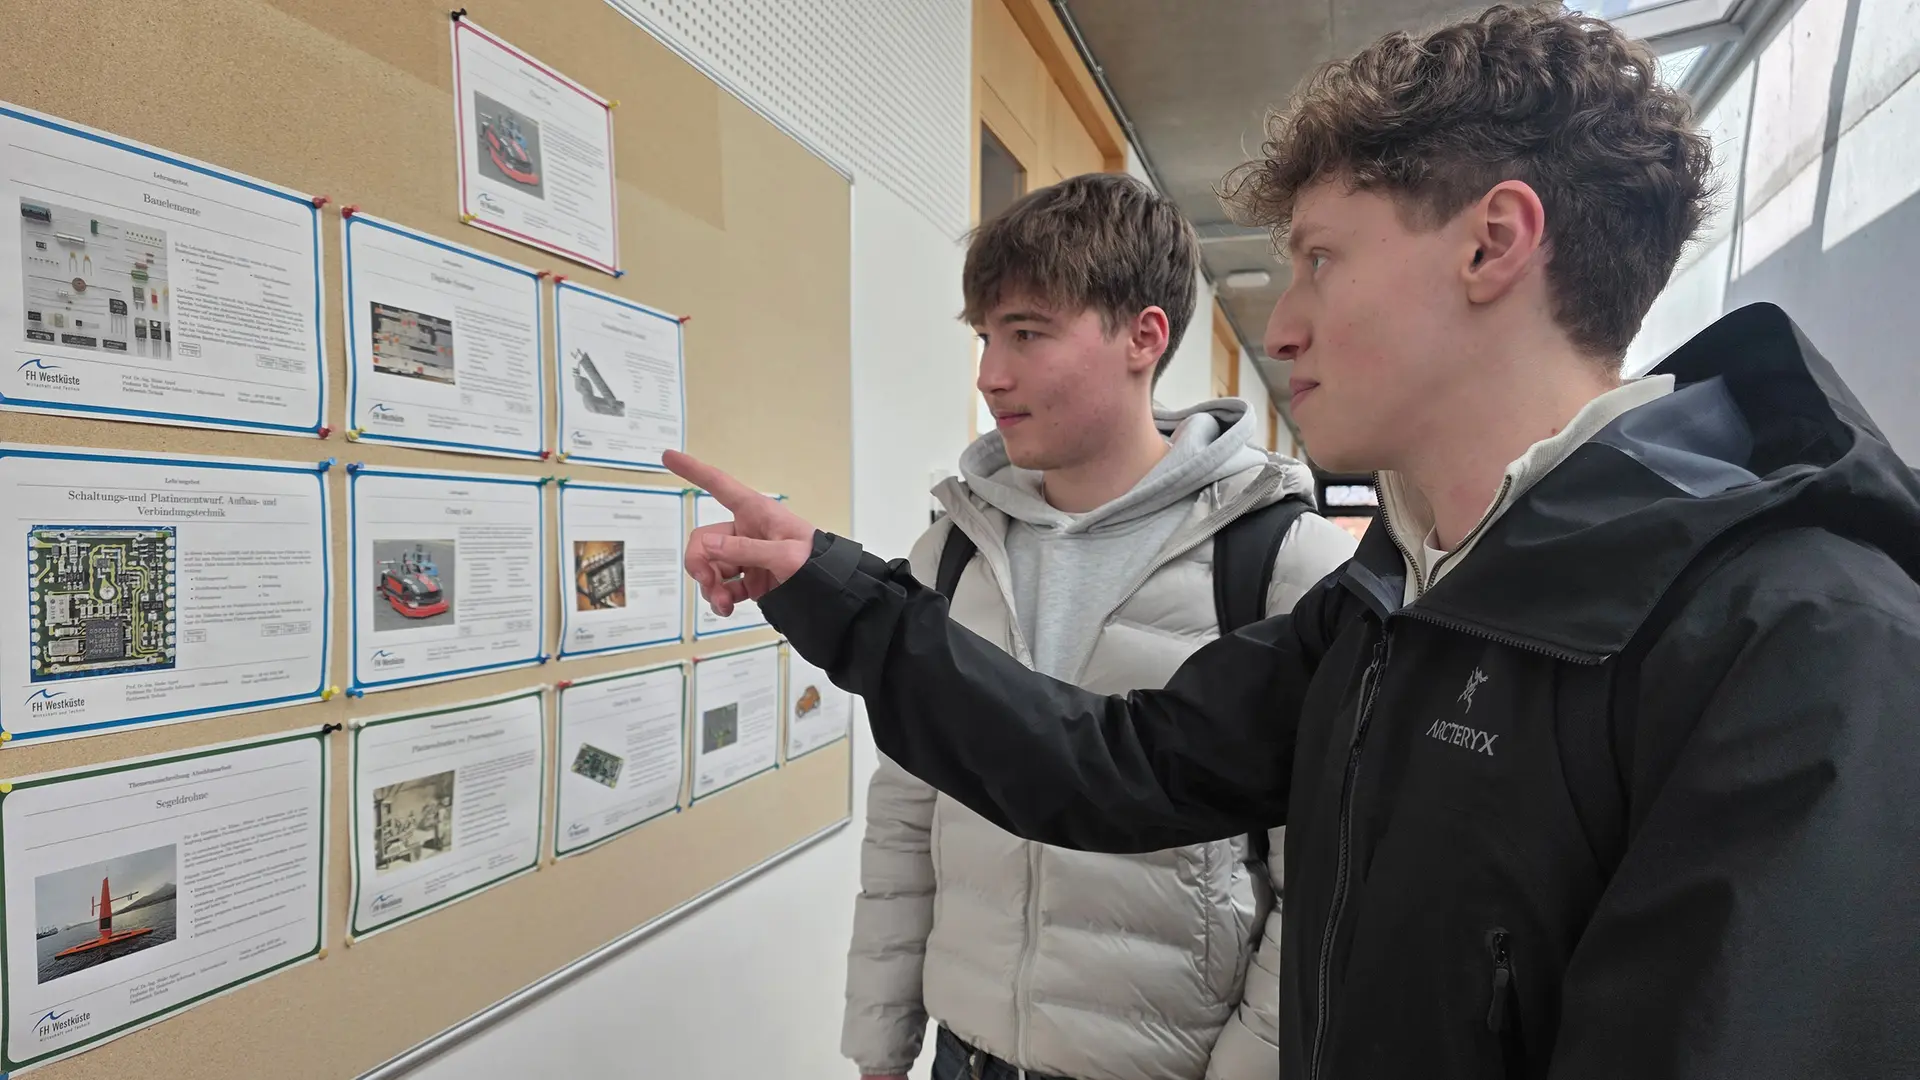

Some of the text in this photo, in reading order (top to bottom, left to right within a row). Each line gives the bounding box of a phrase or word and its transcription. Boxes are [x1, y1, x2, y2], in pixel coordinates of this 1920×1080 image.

[143, 193, 201, 216] Bauelemente
[25, 370, 80, 385] FH Westküste
[68, 490, 147, 504] Schaltungs-und
[262, 498, 277, 506] und
[137, 506, 226, 518] Verbindungstechnik
[32, 697, 85, 712] FH Westküste
[156, 792, 209, 809] Segeldrohne
[39, 1012, 91, 1036] FH Westküste
